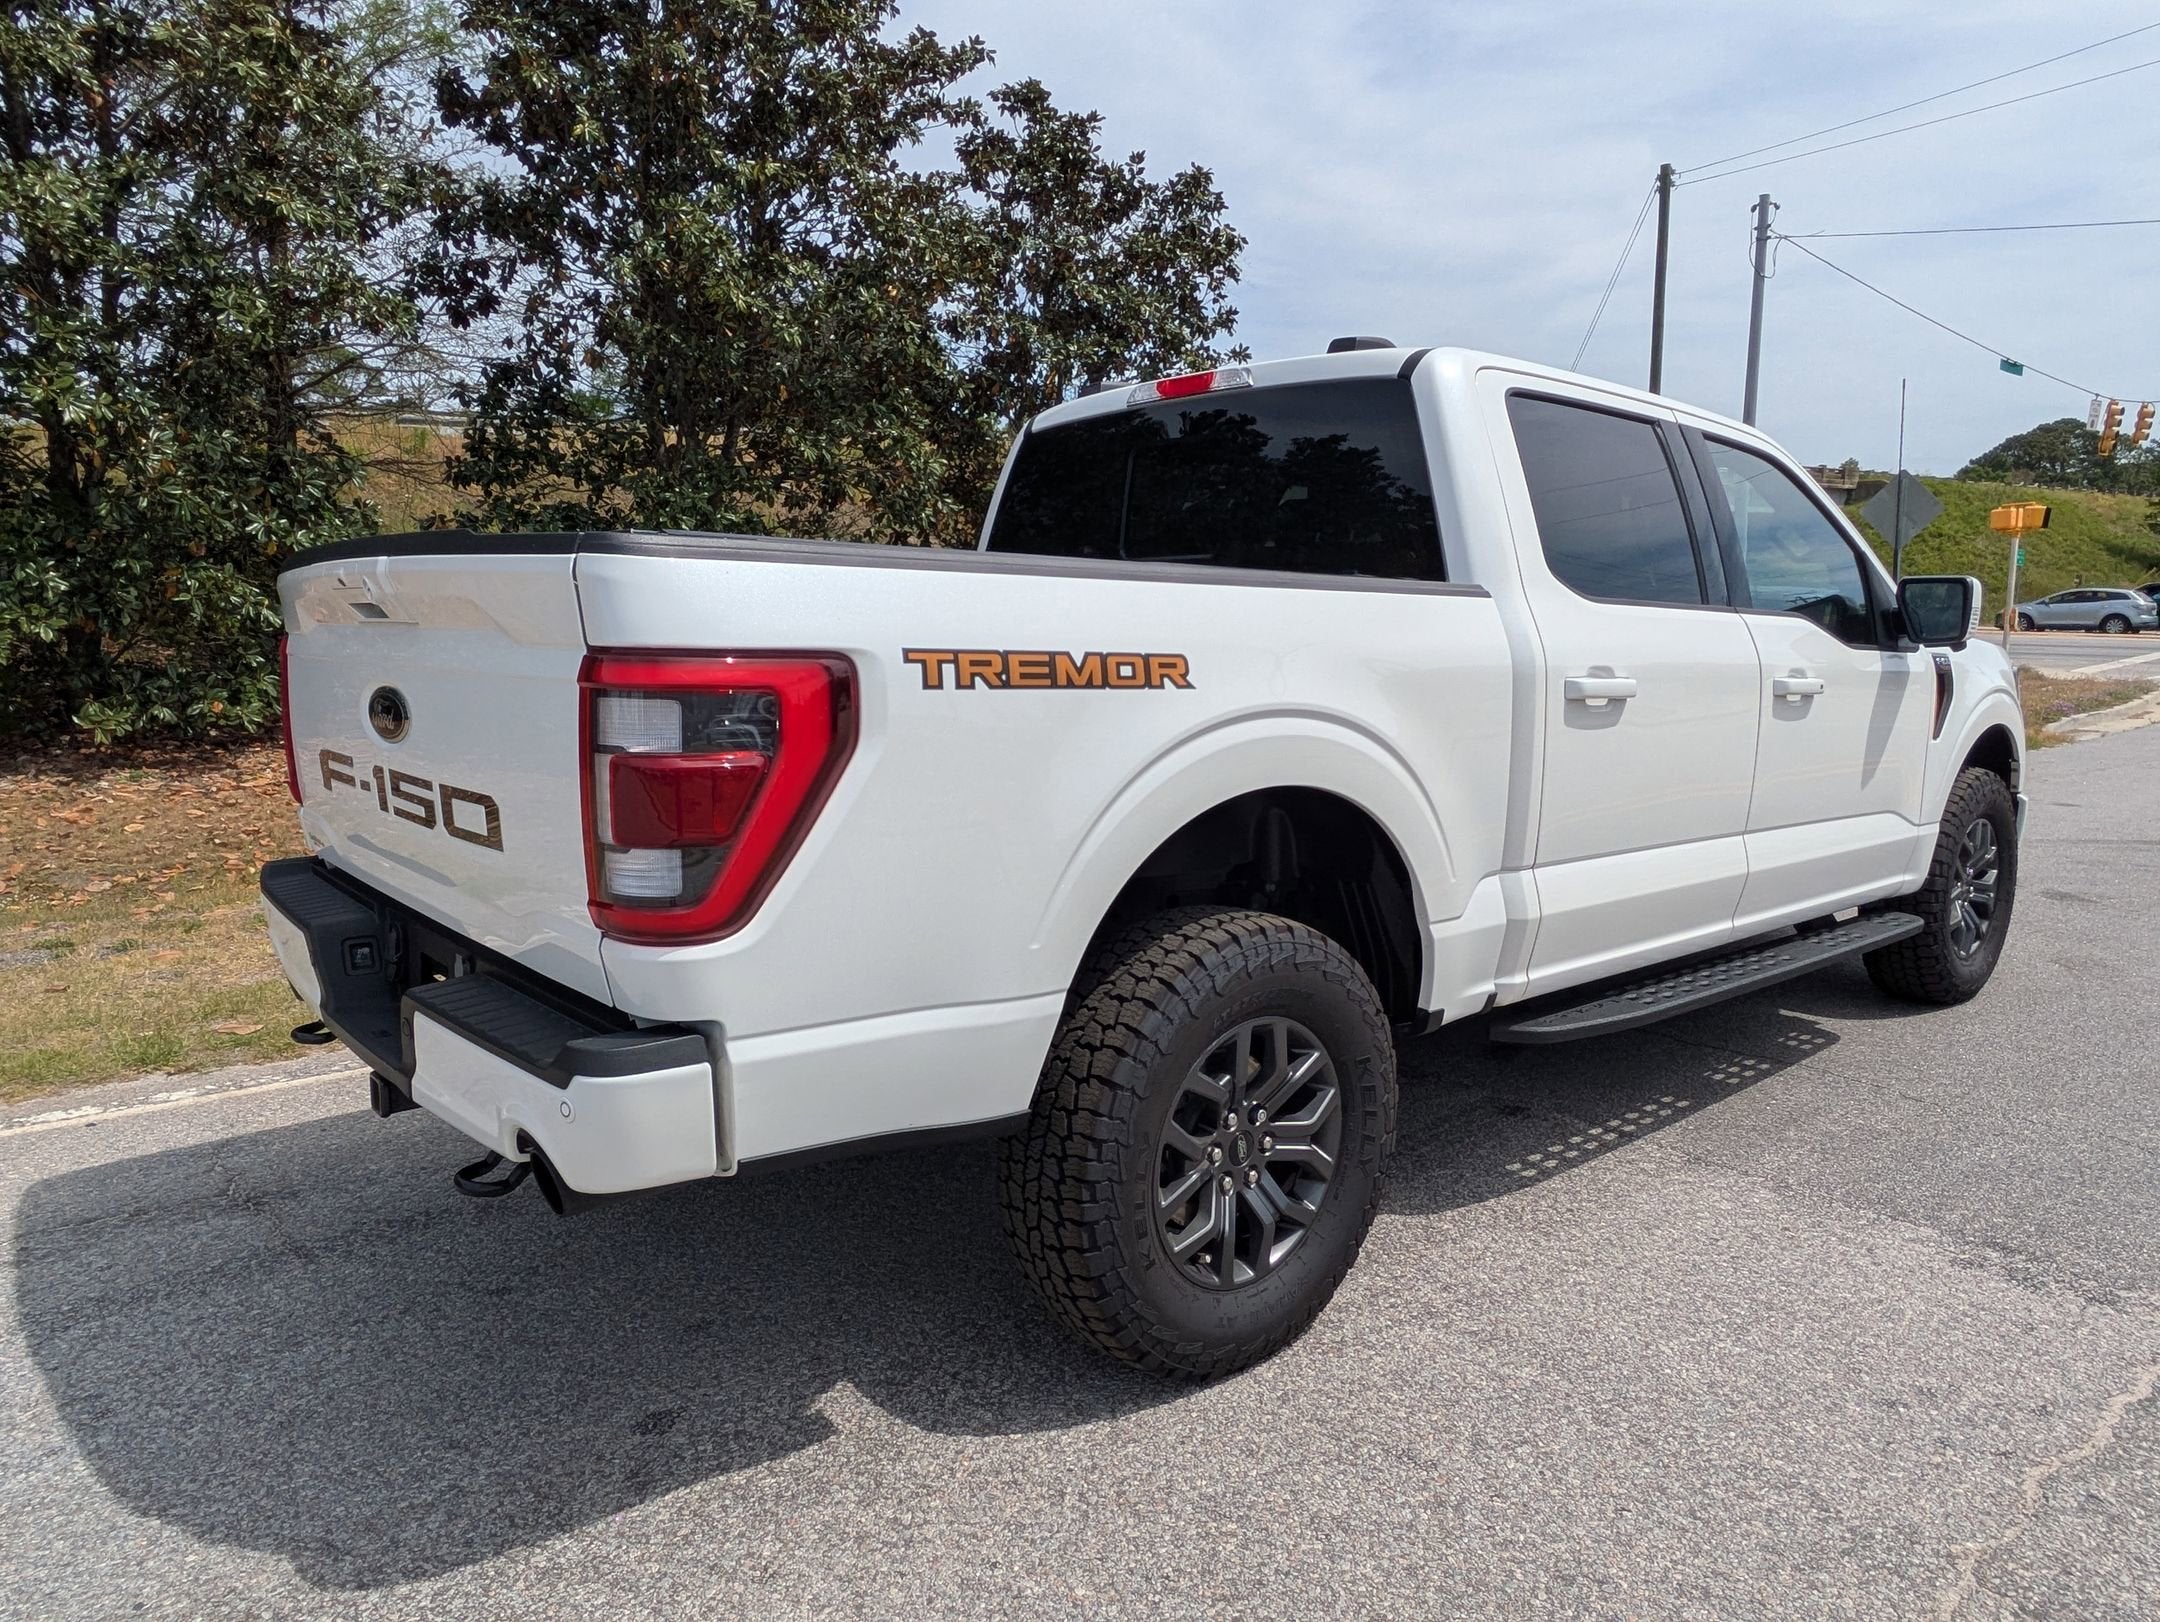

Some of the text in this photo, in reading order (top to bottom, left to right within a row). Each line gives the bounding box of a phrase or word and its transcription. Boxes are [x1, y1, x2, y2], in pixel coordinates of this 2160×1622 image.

[901, 647, 1197, 690] TREMOR
[319, 749, 504, 853] F-150
[1355, 1054, 1378, 1178] KELLY
